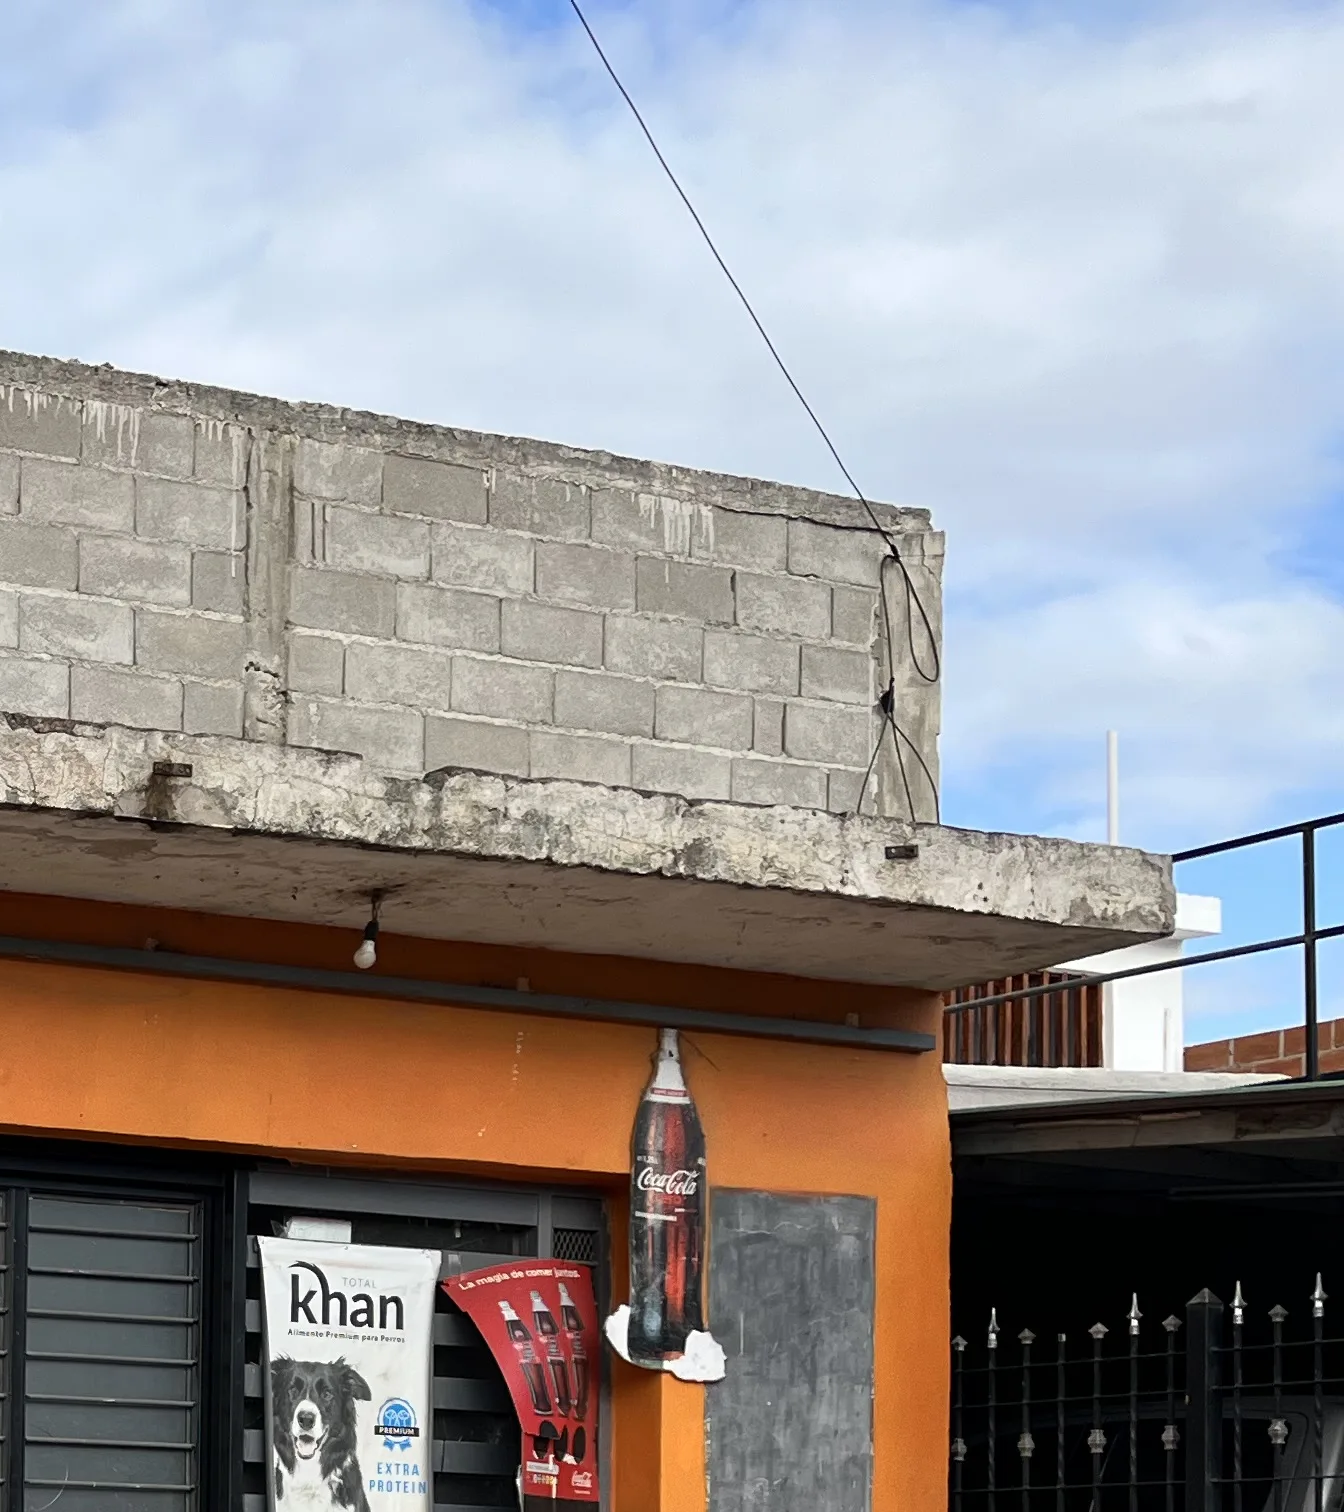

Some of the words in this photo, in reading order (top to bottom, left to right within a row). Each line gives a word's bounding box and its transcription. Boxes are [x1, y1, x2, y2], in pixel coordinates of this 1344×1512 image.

[342, 1276, 377, 1289] TOTAL
[458, 1281, 476, 1290] La
[475, 1272, 510, 1286] magia
[511, 1269, 524, 1278] de
[288, 1260, 404, 1330] khan
[287, 1328, 324, 1338] Alimento
[326, 1331, 359, 1340] Premium
[362, 1334, 379, 1342] para
[381, 1335, 406, 1343] Perros
[378, 1426, 415, 1435] PREMIUM
[377, 1462, 420, 1476] EXTRA
[369, 1479, 427, 1494] PROTEIN
